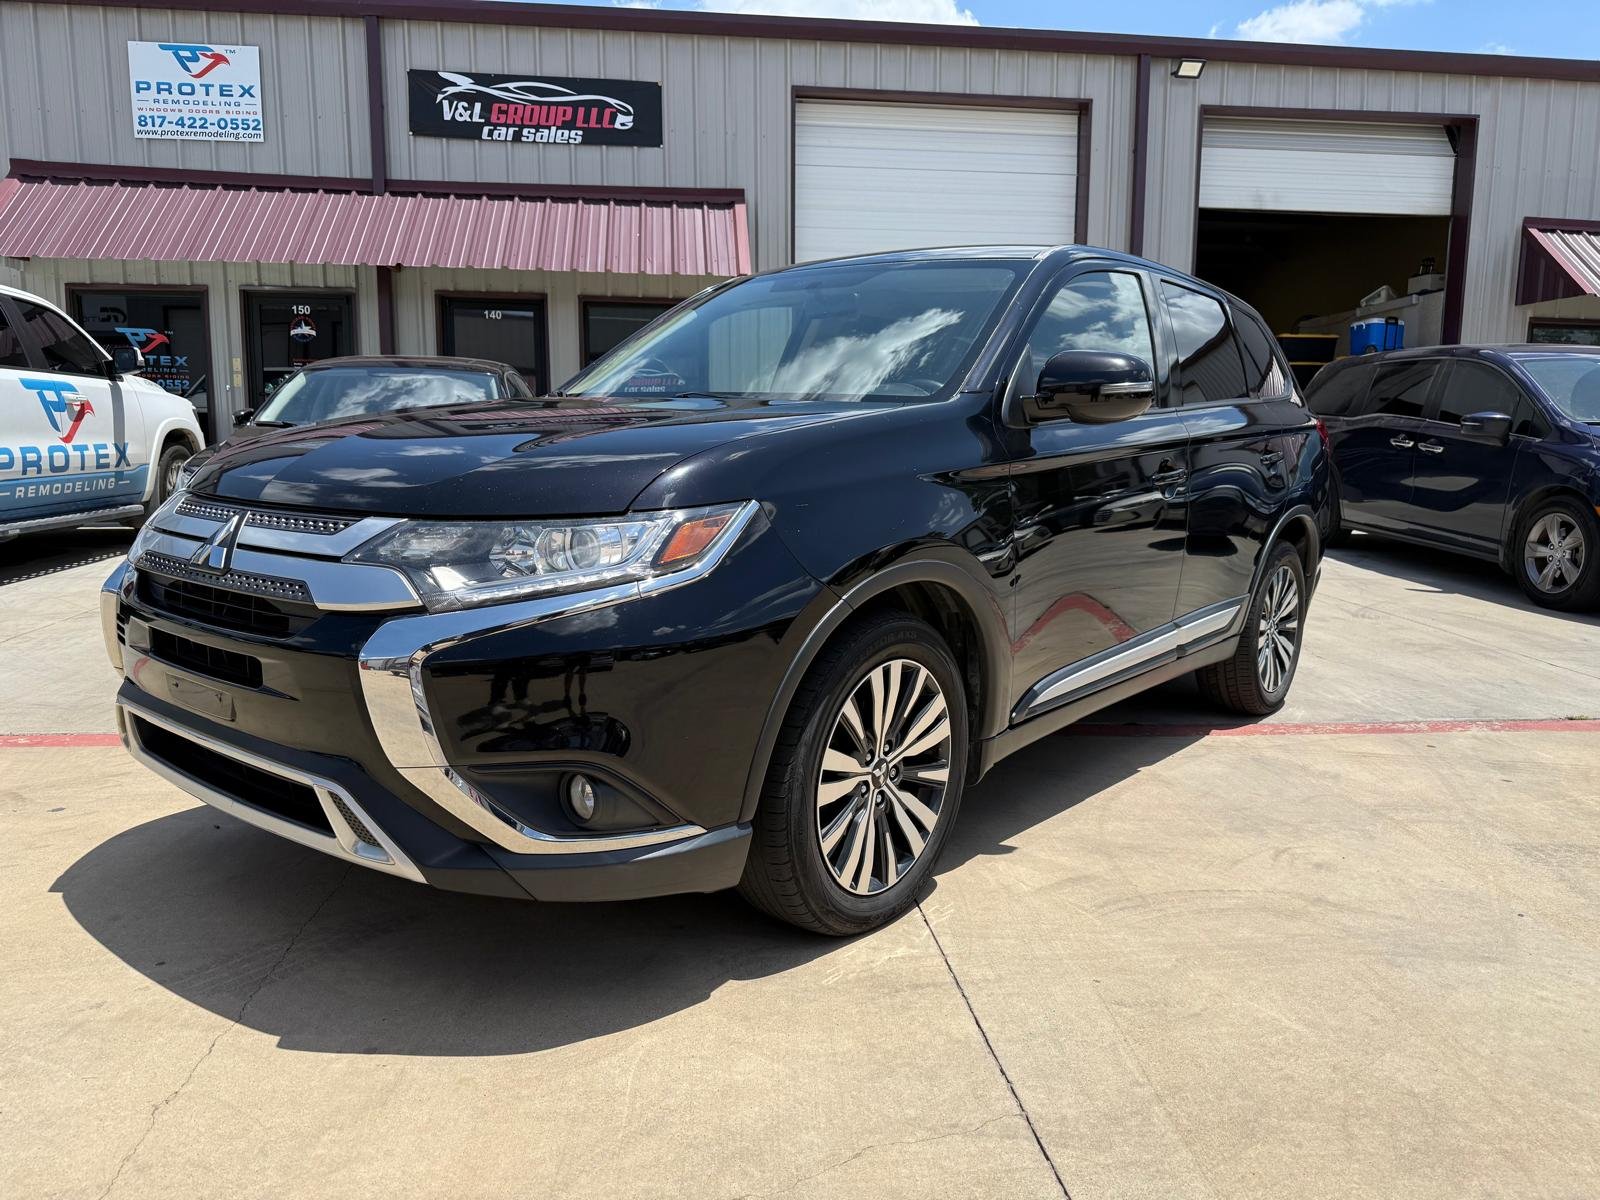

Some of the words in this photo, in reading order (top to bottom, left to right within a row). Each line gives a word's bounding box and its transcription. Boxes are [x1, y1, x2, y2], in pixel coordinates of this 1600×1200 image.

[135, 80, 256, 98] PROTEX
[153, 98, 241, 107] REMODELING
[442, 100, 485, 123] V&L
[490, 103, 572, 127] GROUP
[576, 107, 617, 128] LLC
[137, 115, 262, 131] 817-422-0552
[136, 129, 262, 140] www.protexremodeling.com
[482, 126, 520, 141] car
[521, 127, 583, 144] sales
[291, 305, 311, 315] 150
[484, 310, 502, 320] 140
[145, 355, 187, 366] TEX
[0, 442, 131, 476] PROTEX
[15, 478, 115, 499] REMODELING
